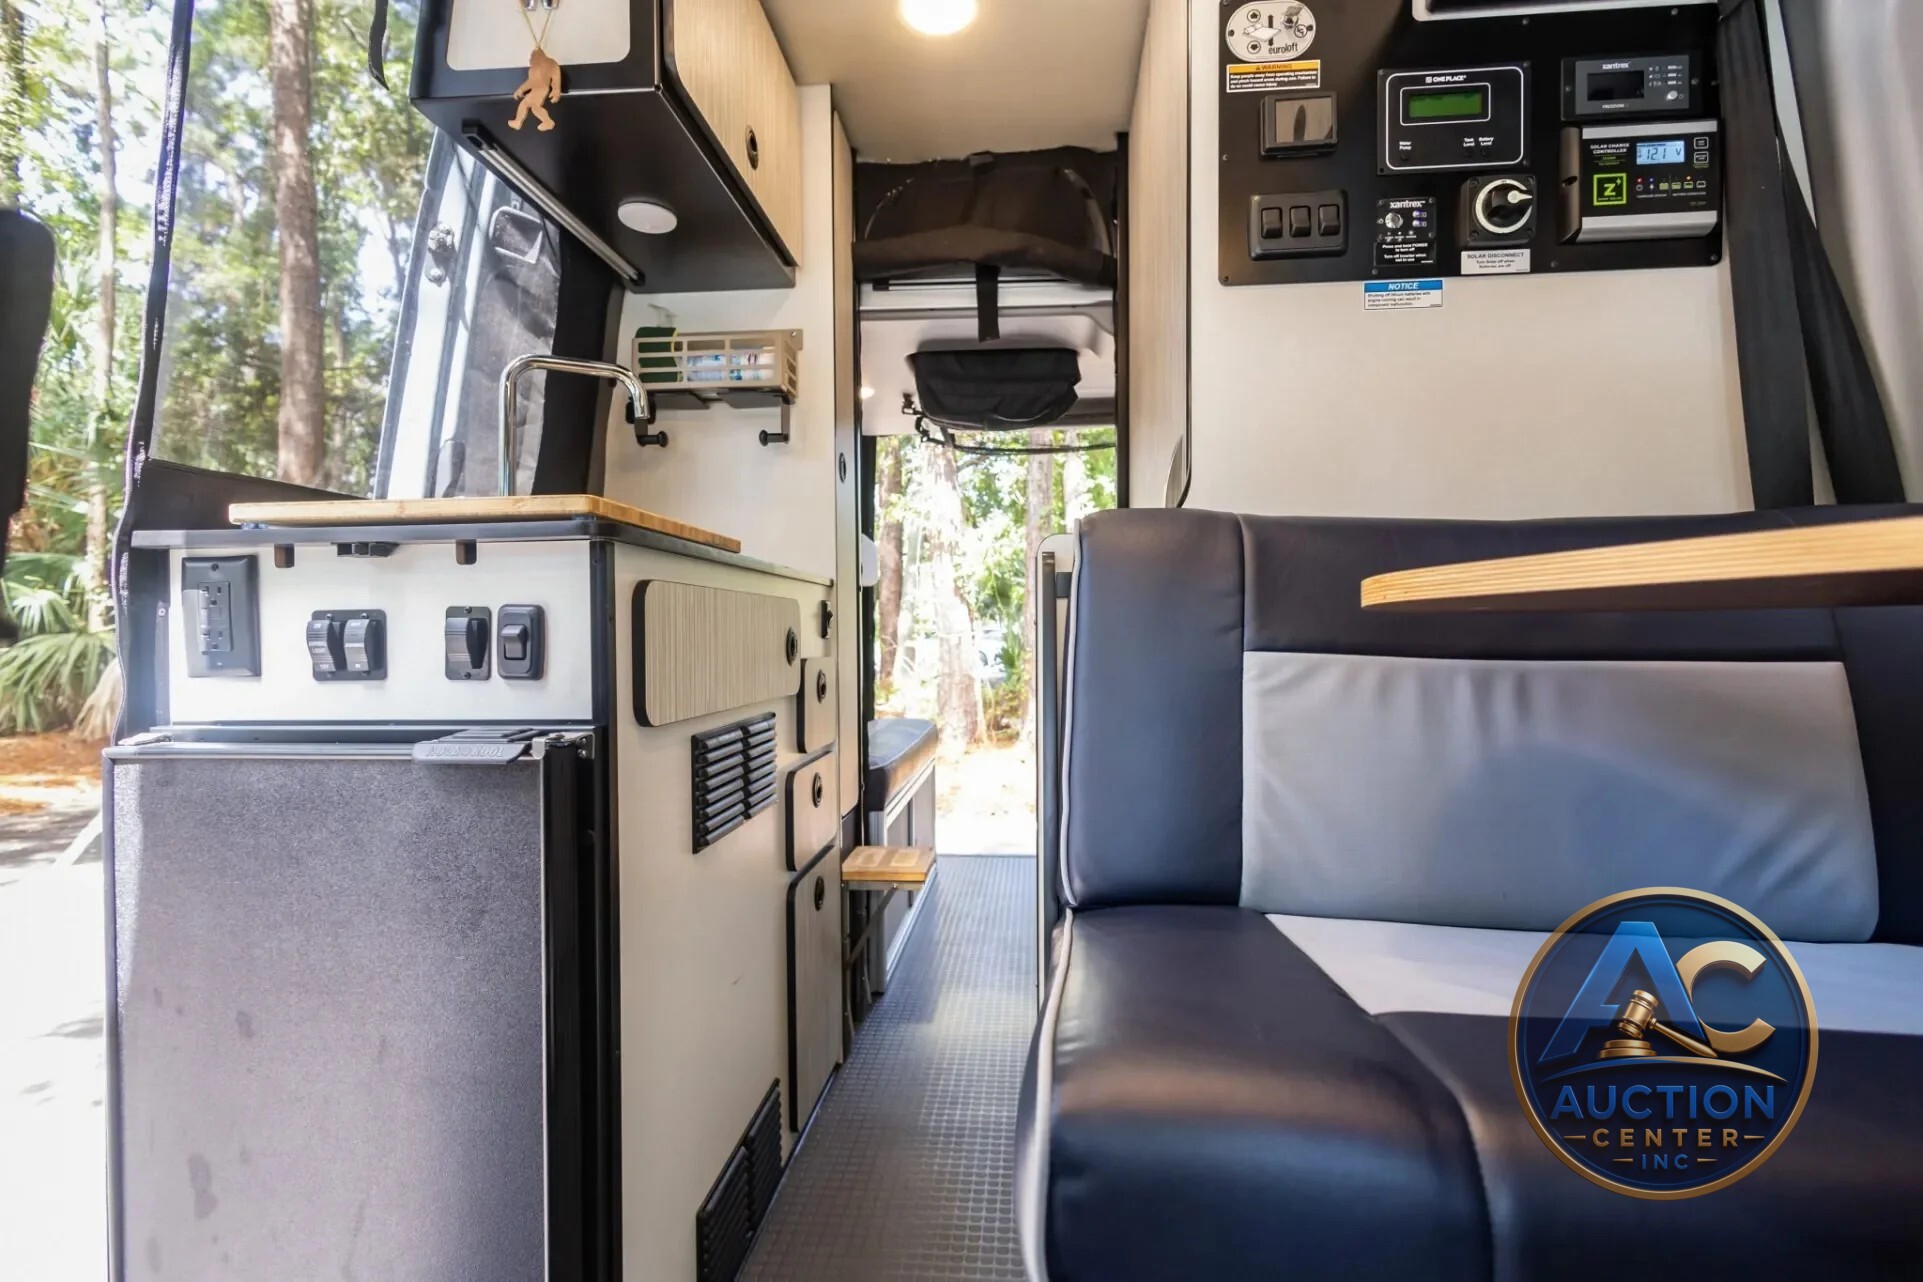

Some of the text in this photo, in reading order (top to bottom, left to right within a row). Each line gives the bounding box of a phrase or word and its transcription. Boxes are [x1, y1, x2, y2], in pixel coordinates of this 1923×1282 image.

[1268, 43, 1298, 54] euroloft
[1389, 200, 1422, 209] xantrex
[1388, 282, 1419, 290] NOTICE
